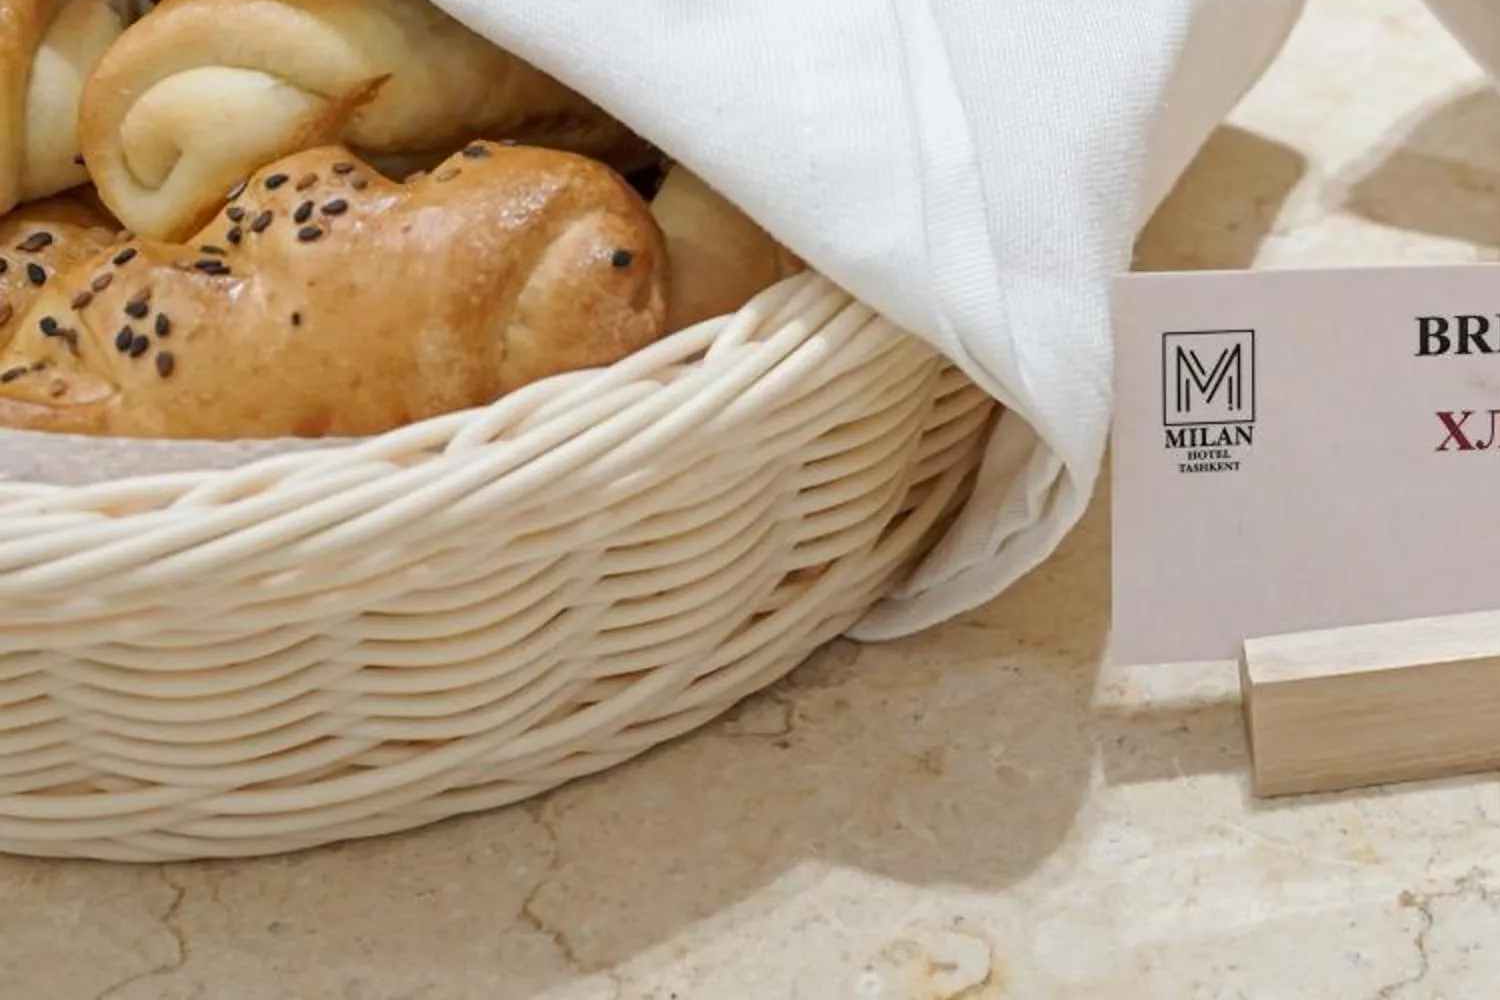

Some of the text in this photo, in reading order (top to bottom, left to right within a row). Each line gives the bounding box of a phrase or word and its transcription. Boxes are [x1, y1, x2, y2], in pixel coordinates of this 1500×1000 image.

[1176, 343, 1241, 413] M
[1165, 425, 1254, 449] MILAN
[1187, 449, 1231, 461] HOTEL
[1178, 461, 1241, 473] TASHKENT
